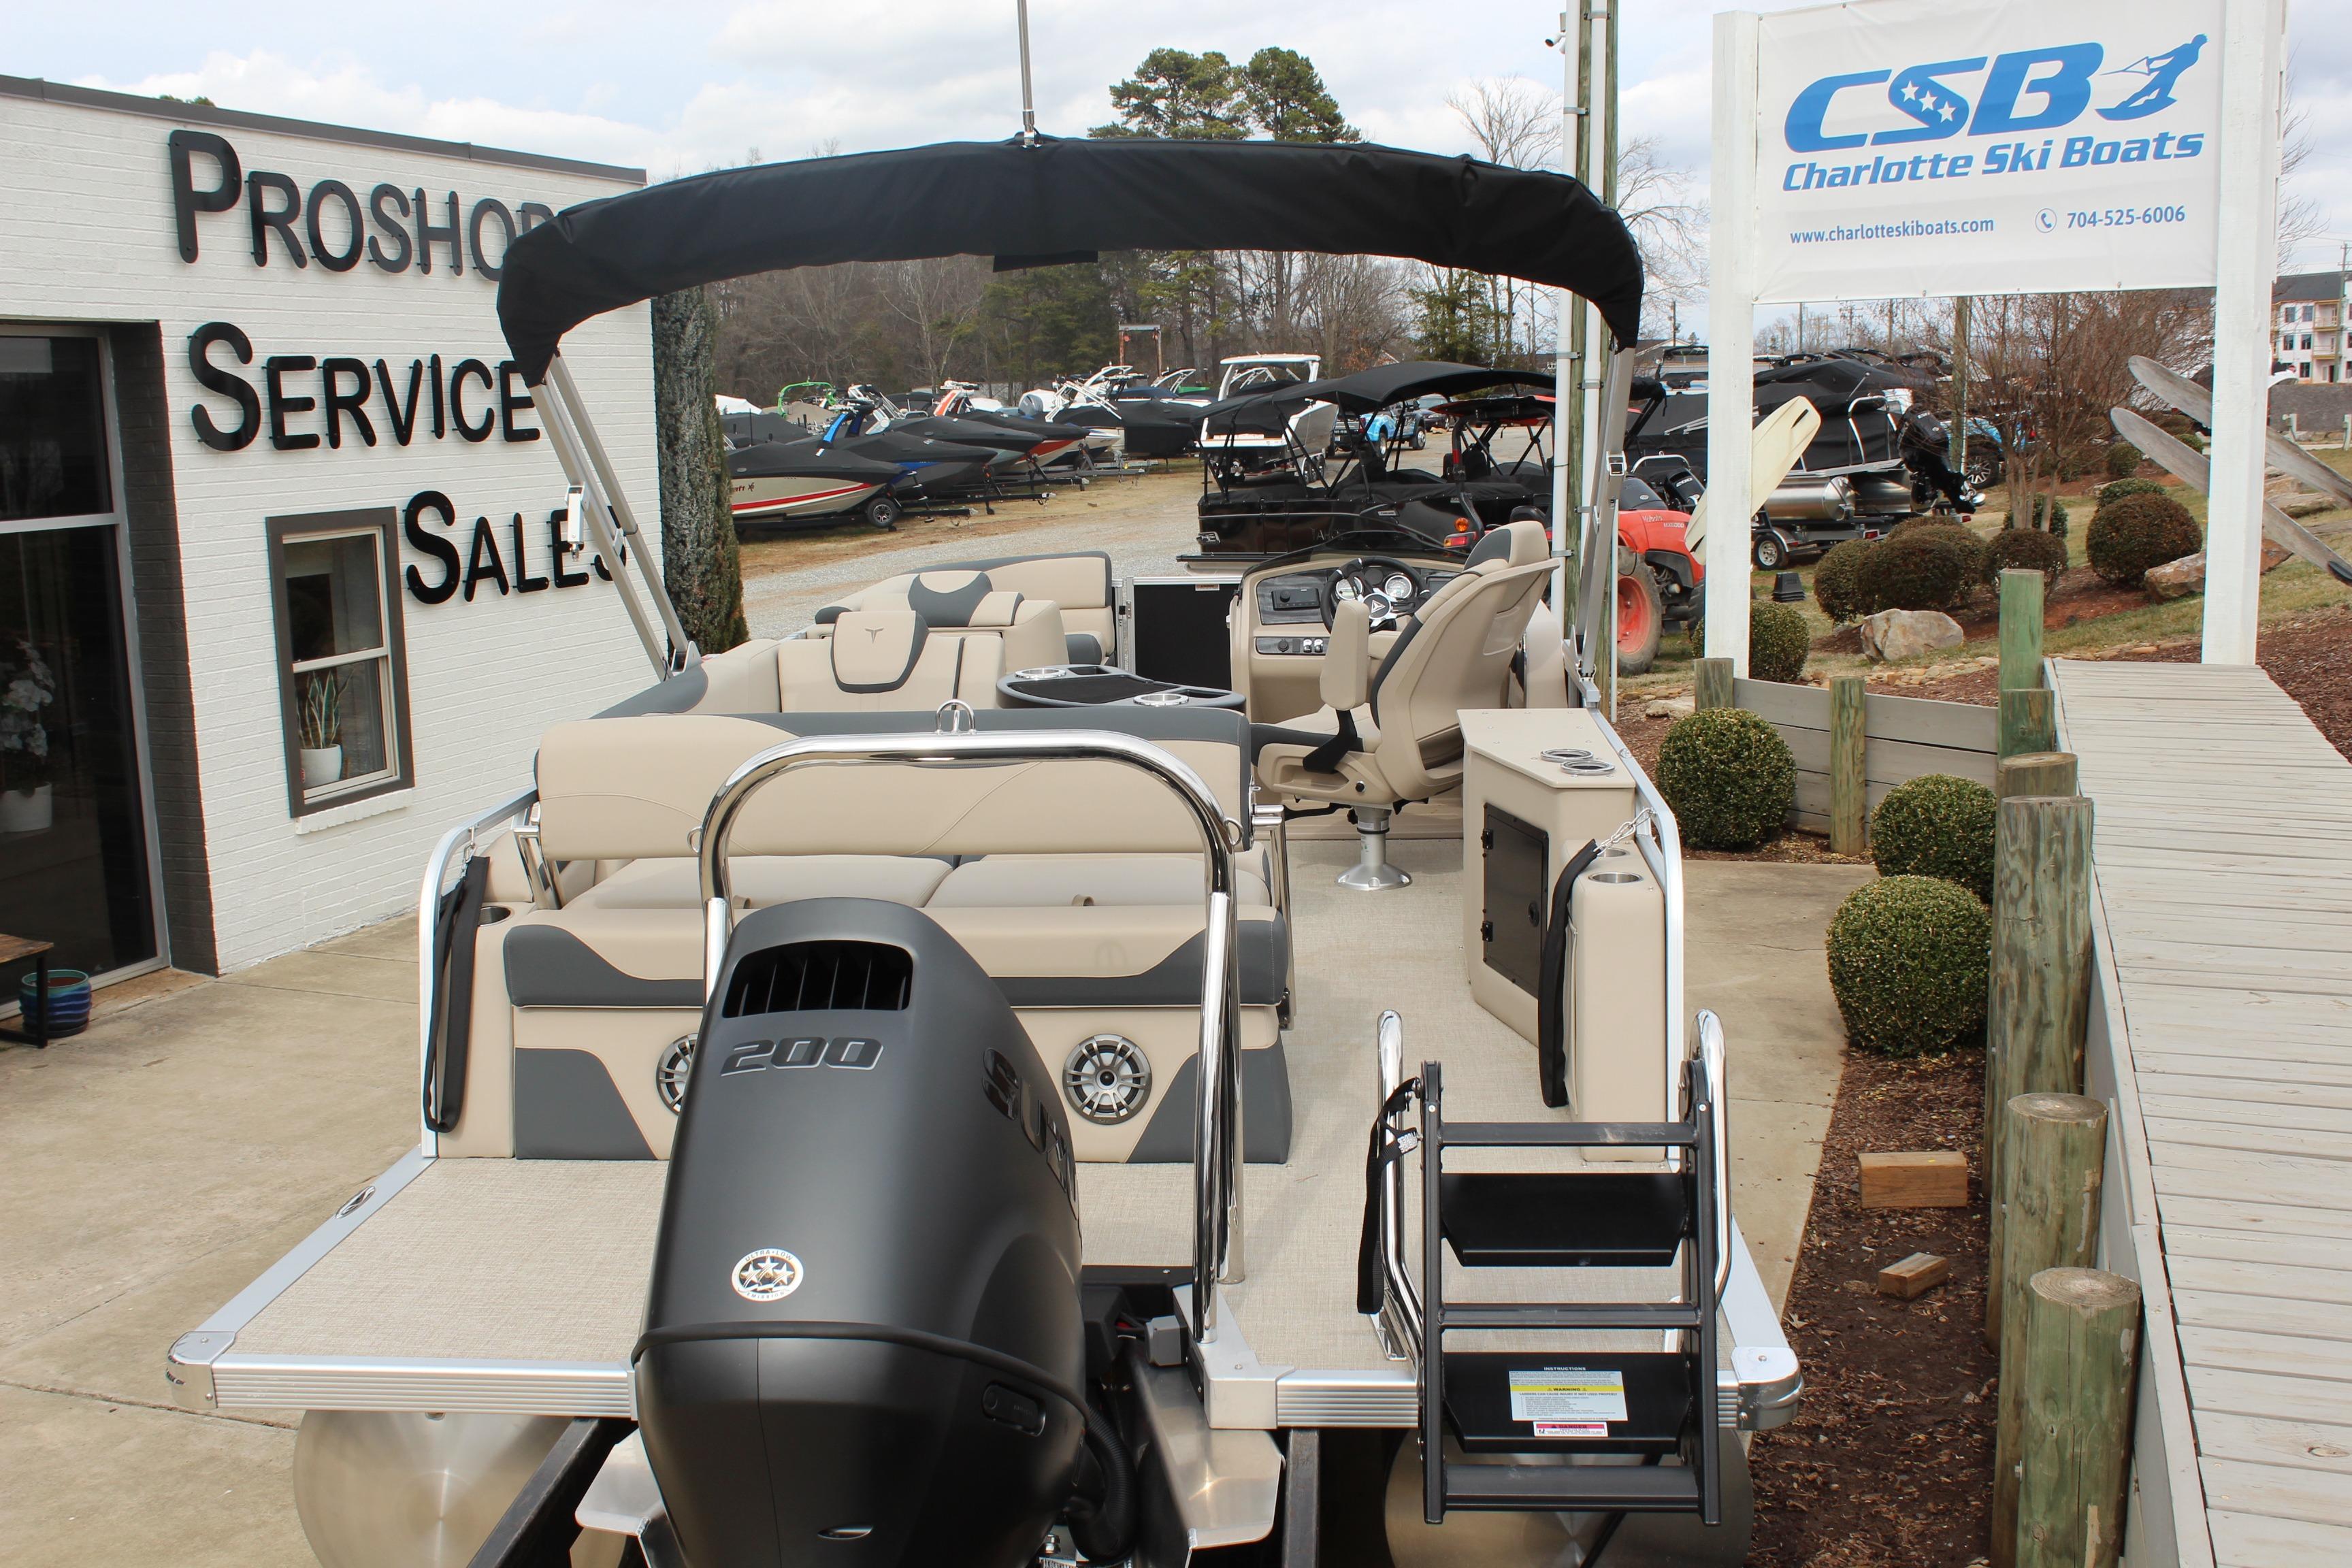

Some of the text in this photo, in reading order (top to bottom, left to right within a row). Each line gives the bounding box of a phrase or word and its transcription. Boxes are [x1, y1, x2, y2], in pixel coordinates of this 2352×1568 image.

[1784, 42, 2104, 153] CSB
[1782, 131, 2205, 191] Charlotte Ski Boats
[1790, 218, 1994, 244] www.charlotteskiboats.com
[2067, 206, 2185, 229] 704-525-6006
[188, 322, 540, 451] SERVICE
[721, 1036, 884, 1077] 200
